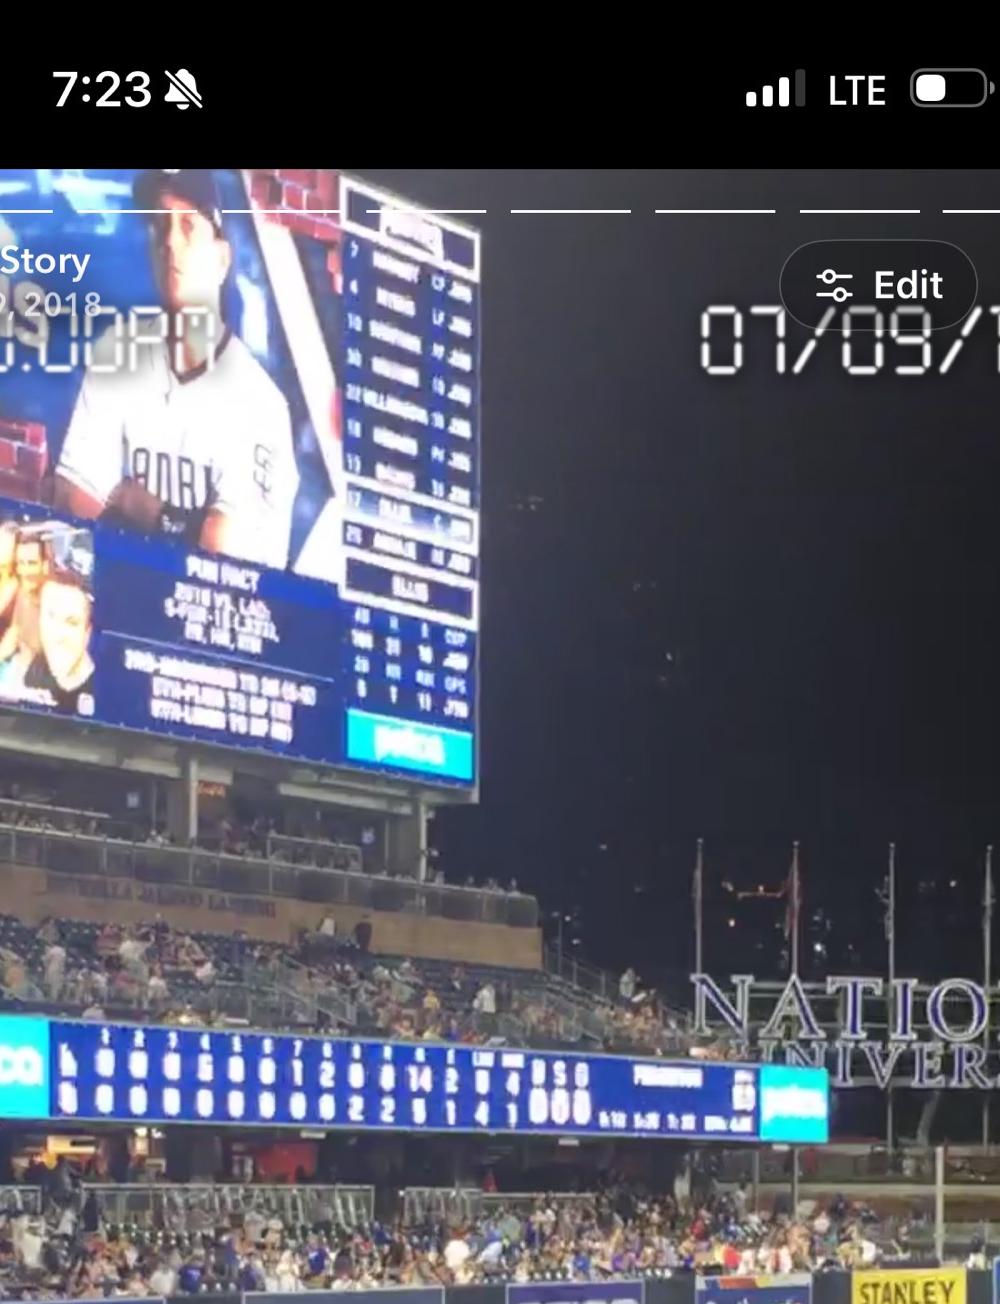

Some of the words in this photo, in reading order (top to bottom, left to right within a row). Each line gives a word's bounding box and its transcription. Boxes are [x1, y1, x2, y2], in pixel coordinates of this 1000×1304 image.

[690, 972, 1000, 1042] NATIO
[319, 1061, 336, 1088] 2
[348, 1095, 365, 1122] 2
[380, 1096, 396, 1123] 2
